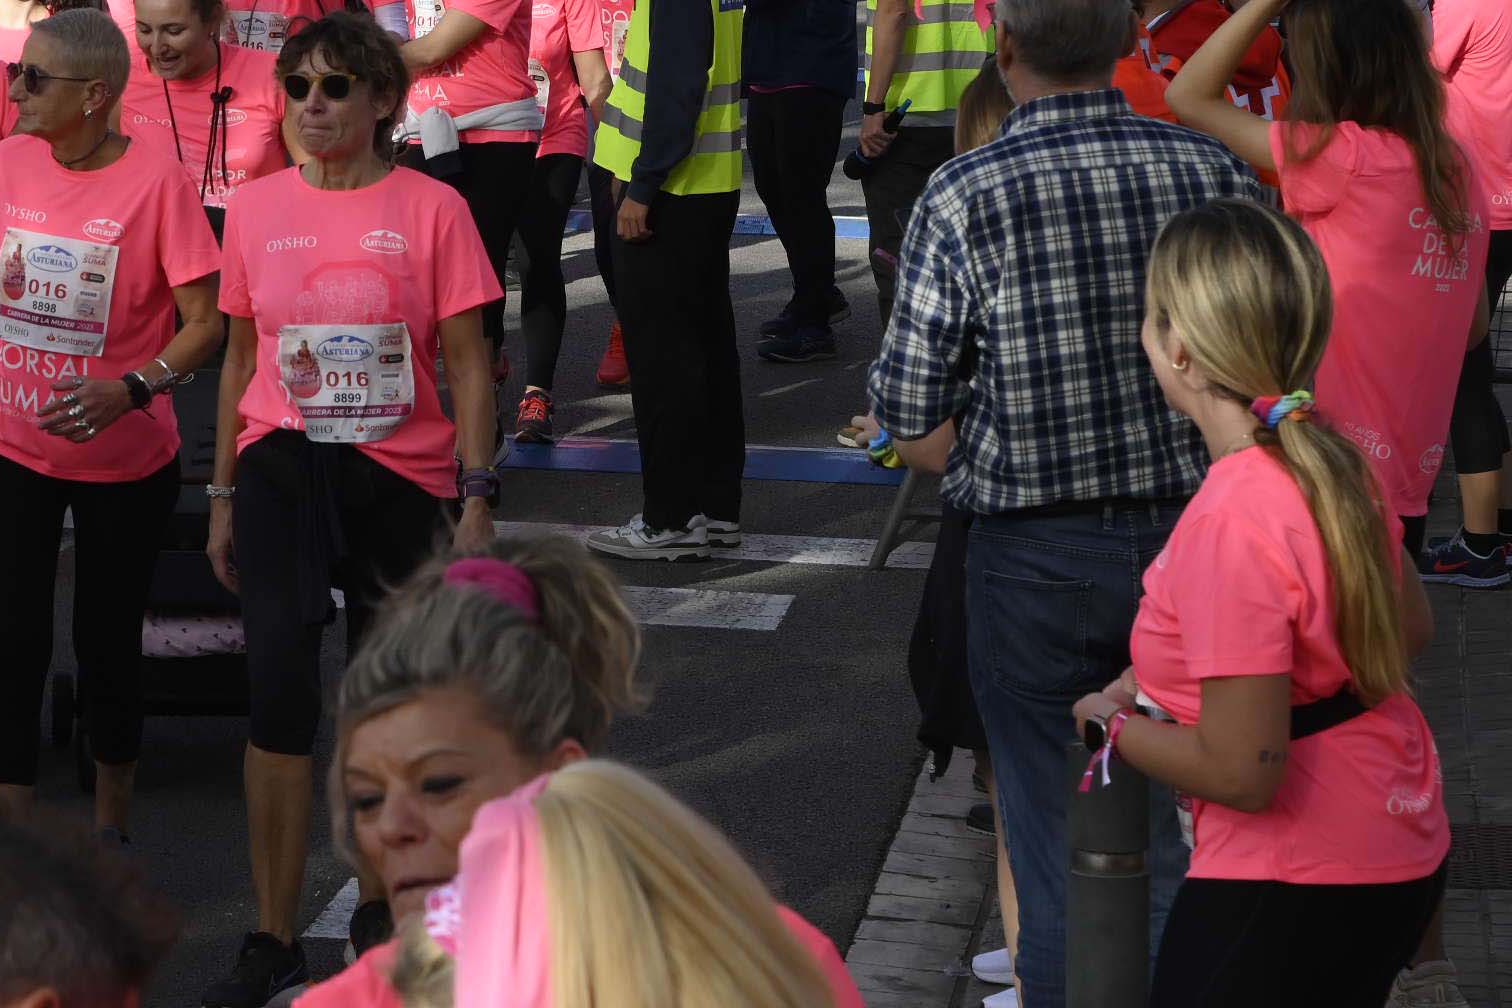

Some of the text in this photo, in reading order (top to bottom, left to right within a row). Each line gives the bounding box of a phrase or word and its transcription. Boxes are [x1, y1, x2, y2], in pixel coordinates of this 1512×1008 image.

[266, 236, 317, 253] OYSHO
[31, 254, 73, 269] ASTURIANA
[1412, 255, 1469, 281] MUJER
[28, 278, 69, 299] 016
[32, 300, 57, 314] 8898
[4, 322, 29, 338] OYSHO
[51, 318, 76, 329] MUJER
[322, 346, 369, 357] ASTURIANA
[326, 370, 369, 388] 016
[334, 392, 362, 404] 8899
[302, 408, 332, 417] ARRERA
[333, 408, 345, 416] DE
[345, 408, 355, 416] LA
